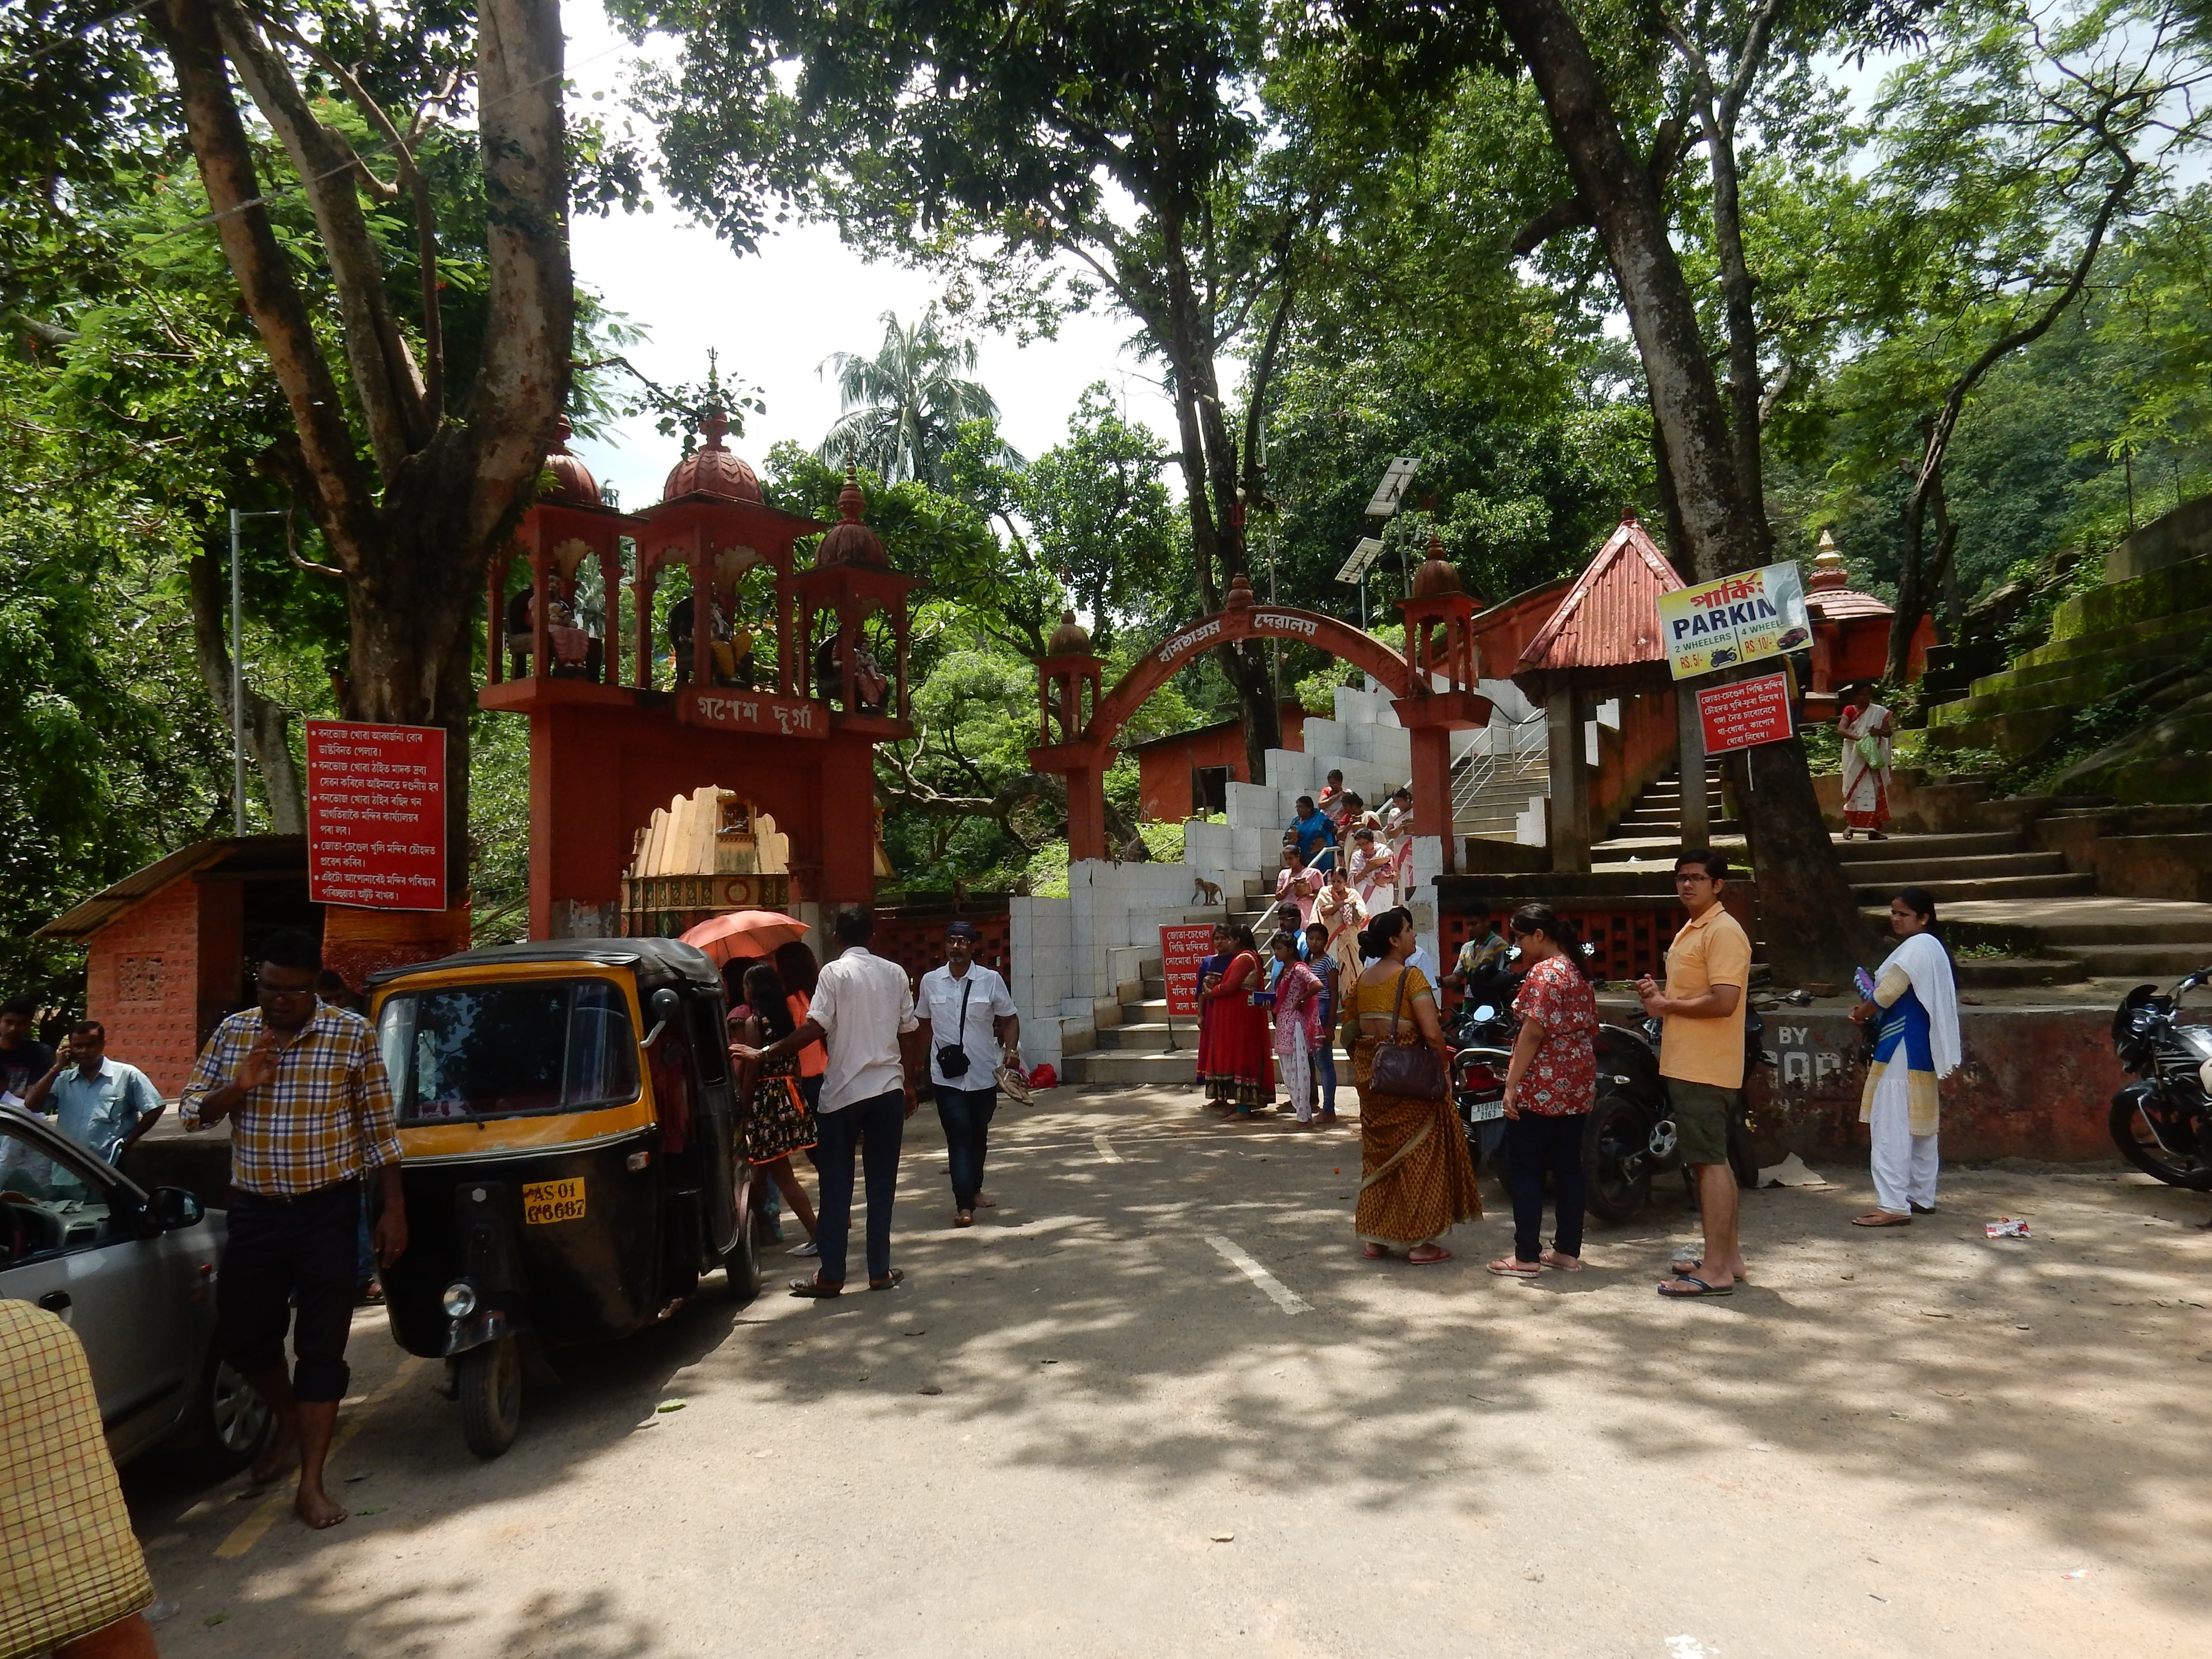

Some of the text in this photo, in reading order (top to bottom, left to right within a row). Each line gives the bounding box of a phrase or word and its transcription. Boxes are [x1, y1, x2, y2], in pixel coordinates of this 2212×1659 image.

[1673, 599, 1777, 639] PARKIN
[1749, 620, 1784, 634] WHEEL
[1683, 633, 1732, 651] WHEELERS
[1778, 1027, 1809, 1046] BY
